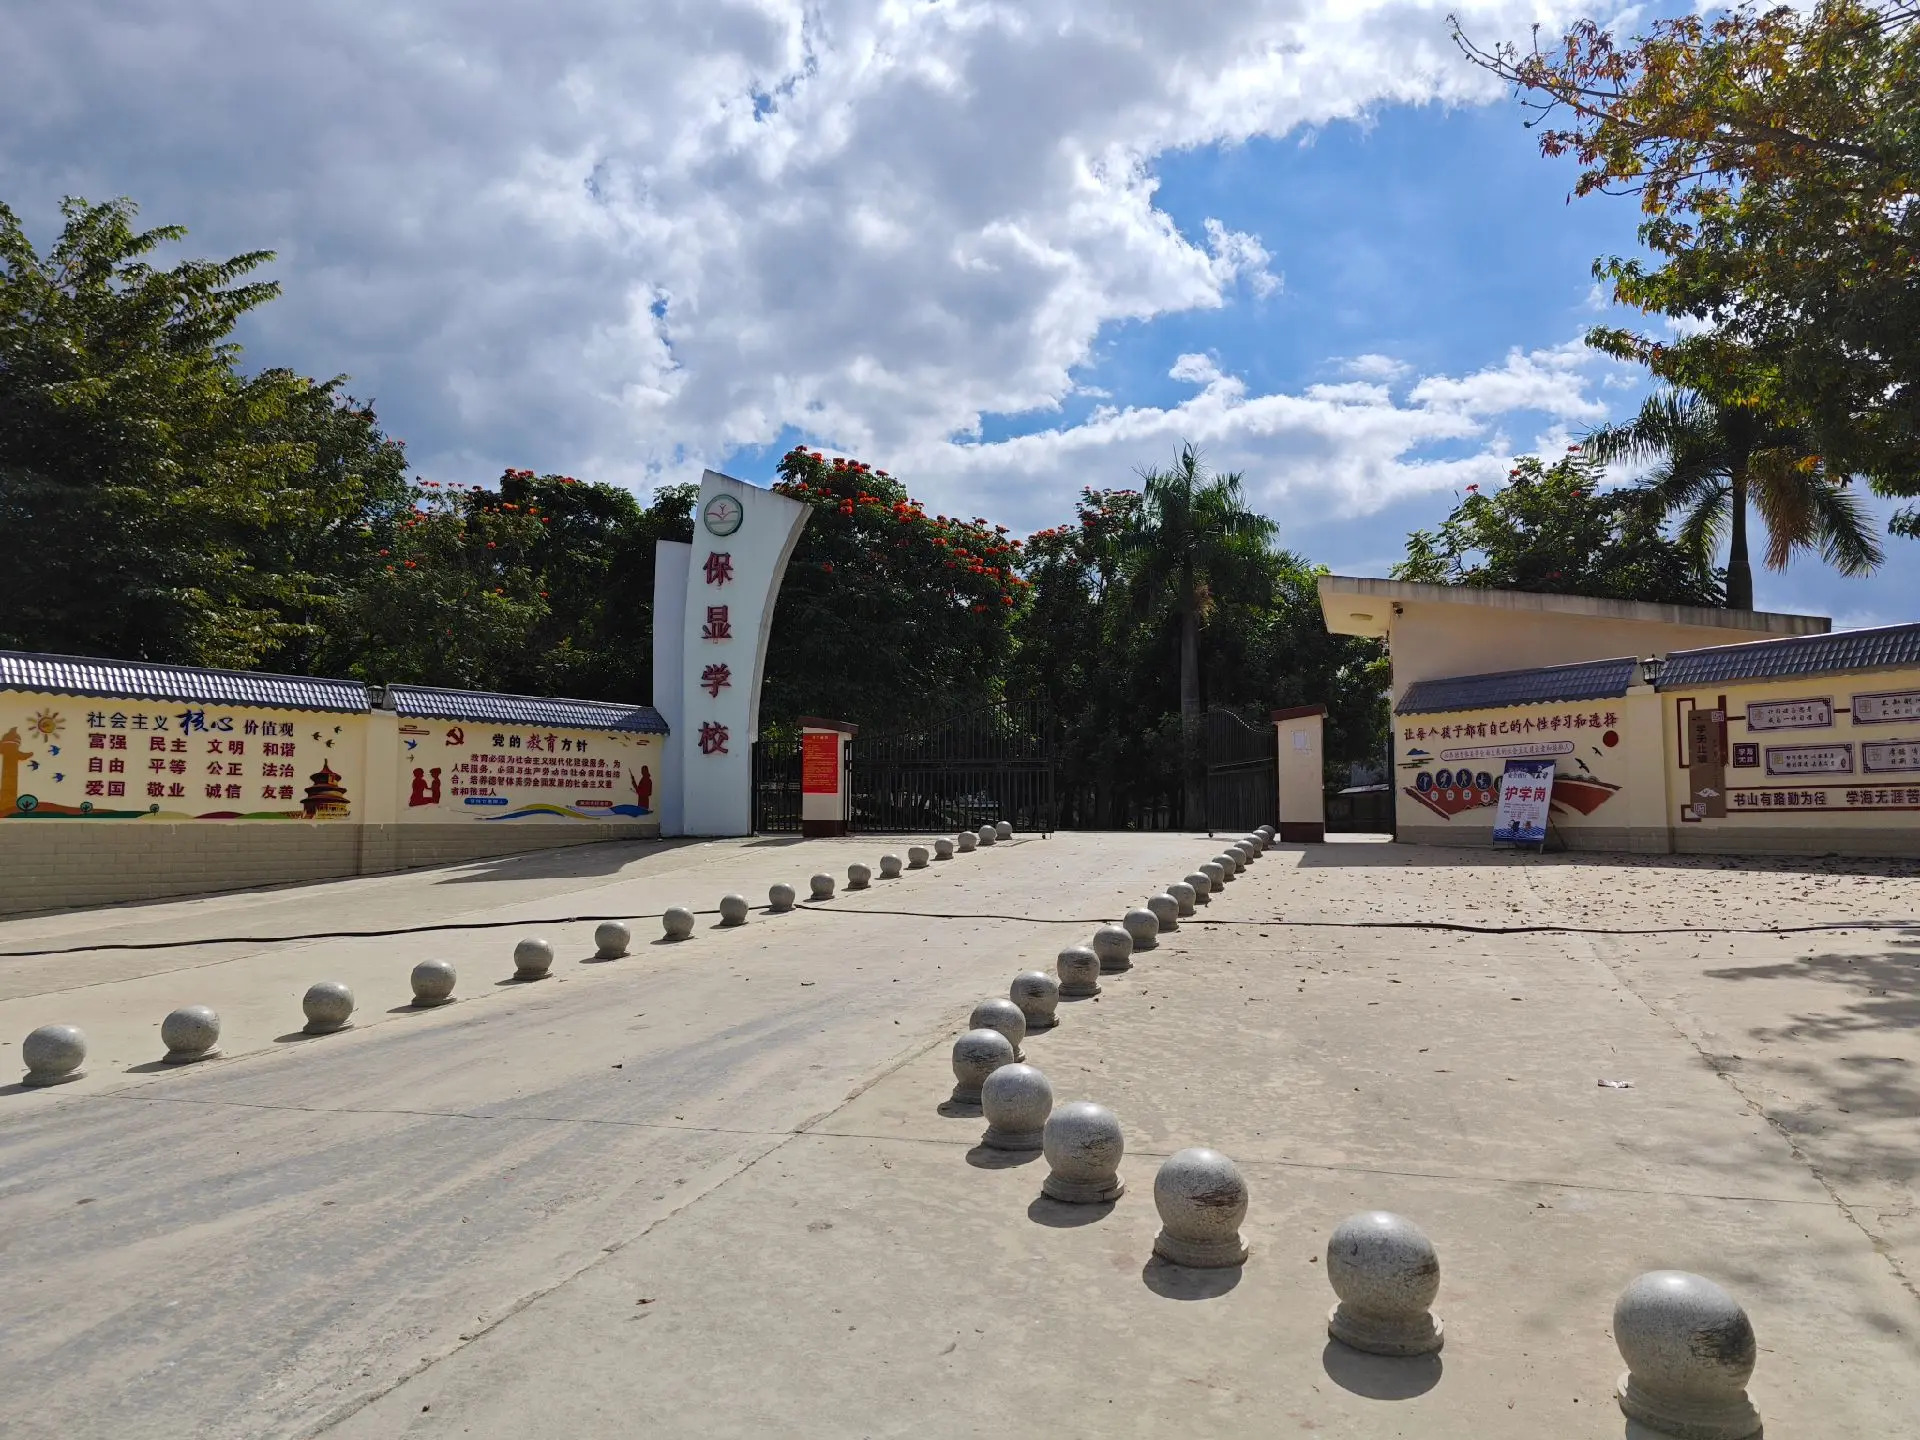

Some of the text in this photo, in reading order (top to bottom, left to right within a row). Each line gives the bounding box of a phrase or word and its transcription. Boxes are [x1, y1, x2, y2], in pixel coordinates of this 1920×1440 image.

[699, 551, 734, 755] 保显学校
[87, 708, 295, 738] 社会主义核心价值观
[1404, 712, 1619, 741] 让每个孩子都有自己的个性学习和选择
[88, 733, 296, 758] 富强 民主 文明 和谐
[493, 733, 588, 752] 党的教育方针
[88, 757, 295, 778] 自由 平等 公正 法治
[86, 780, 294, 800] 爱国 敬业 诚信 友善
[1505, 786, 1546, 802] 护学岗
[1734, 791, 1827, 807] 书山有路勤为径
